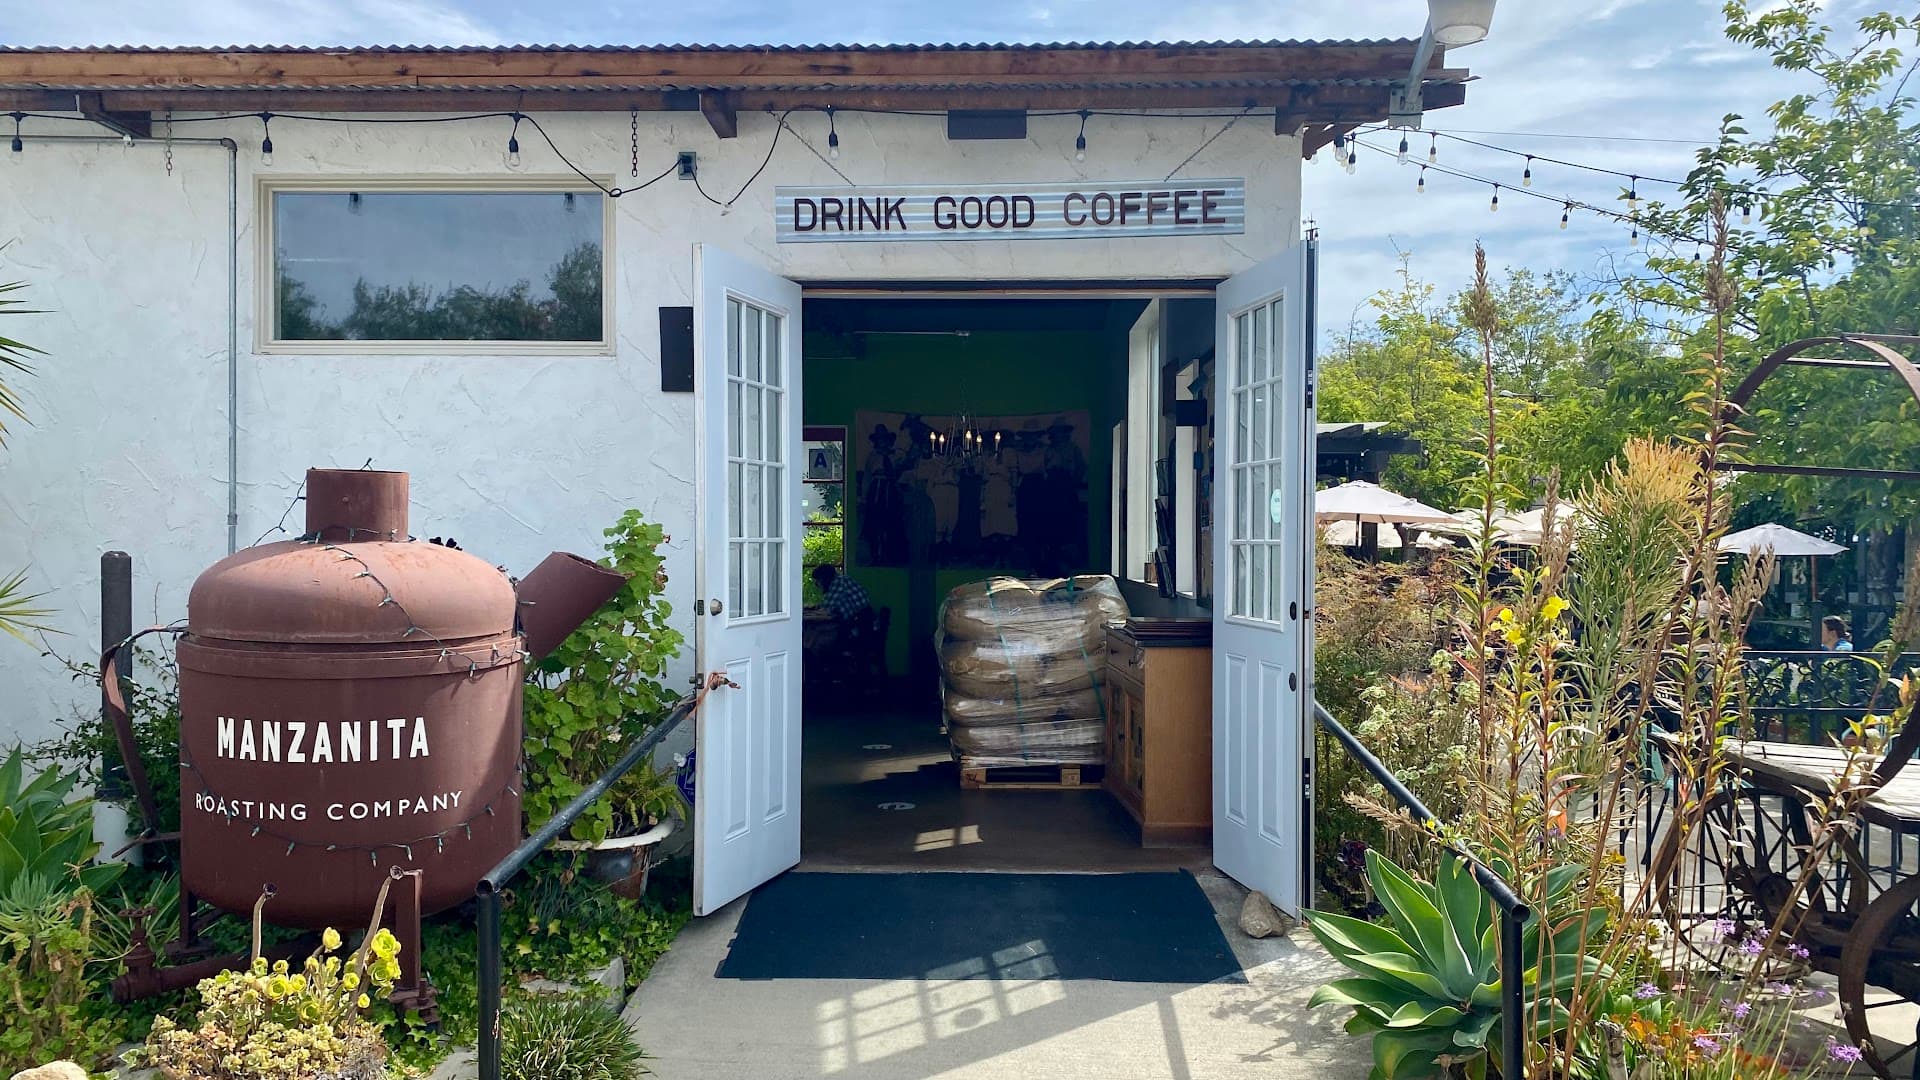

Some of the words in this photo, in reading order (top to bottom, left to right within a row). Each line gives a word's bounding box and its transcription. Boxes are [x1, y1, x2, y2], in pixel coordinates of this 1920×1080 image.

[794, 197, 907, 231] DRINK
[933, 195, 1036, 229] GOOD
[1063, 190, 1226, 225] COFFEE
[814, 452, 827, 468] A
[217, 716, 429, 763] MANZANITA
[195, 792, 308, 820] ROASTING
[326, 790, 463, 820] COMPANY
